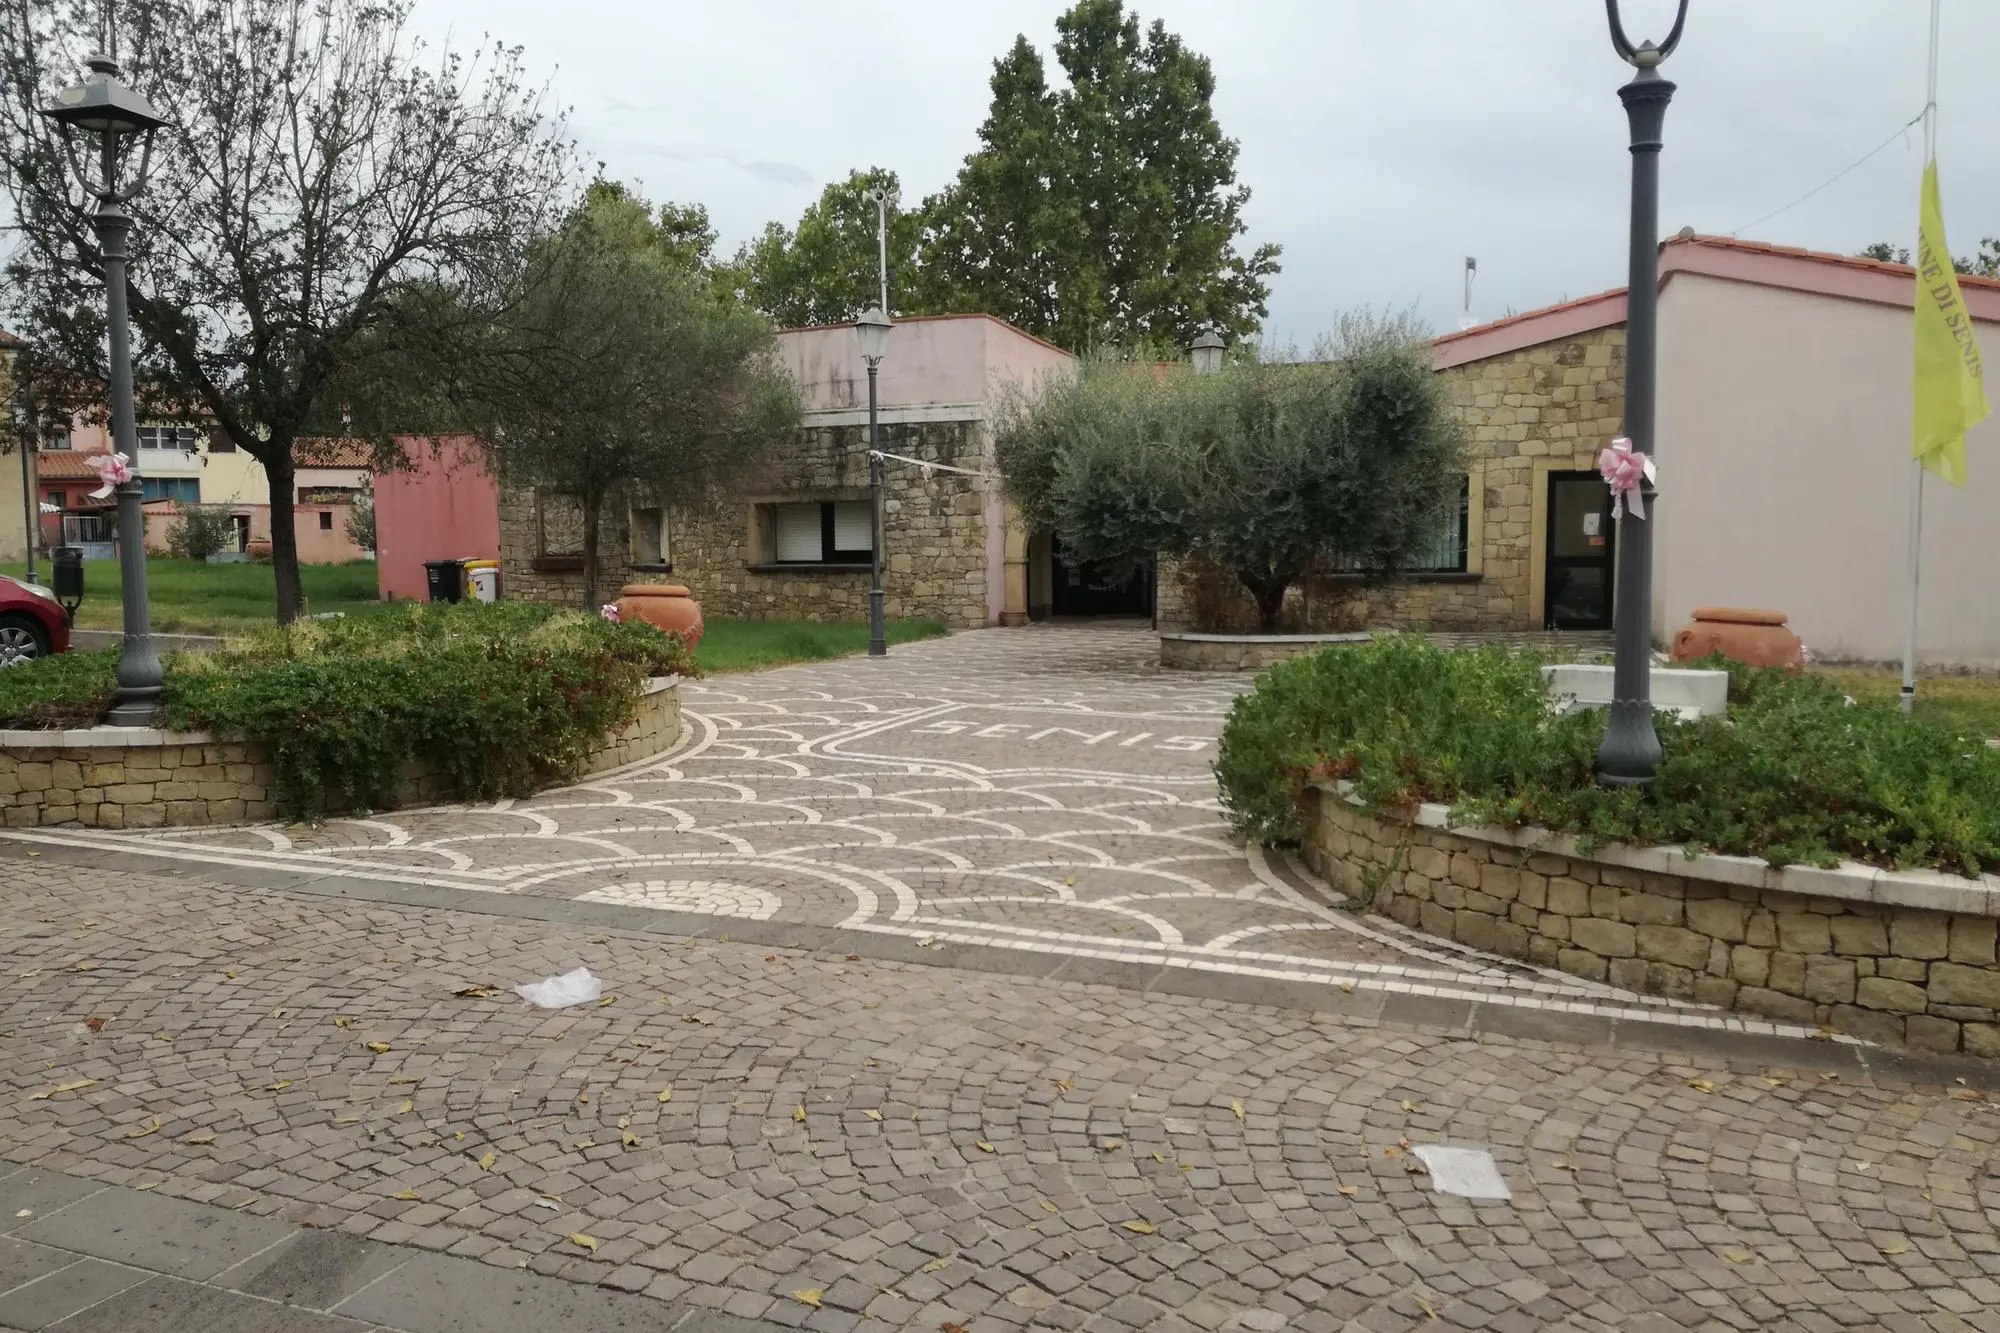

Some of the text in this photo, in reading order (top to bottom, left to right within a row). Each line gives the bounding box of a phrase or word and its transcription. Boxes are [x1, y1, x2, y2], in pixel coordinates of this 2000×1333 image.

[1930, 283, 1957, 312] DI
[1945, 312, 1982, 378] SENIS
[912, 720, 1219, 751] SENIS
